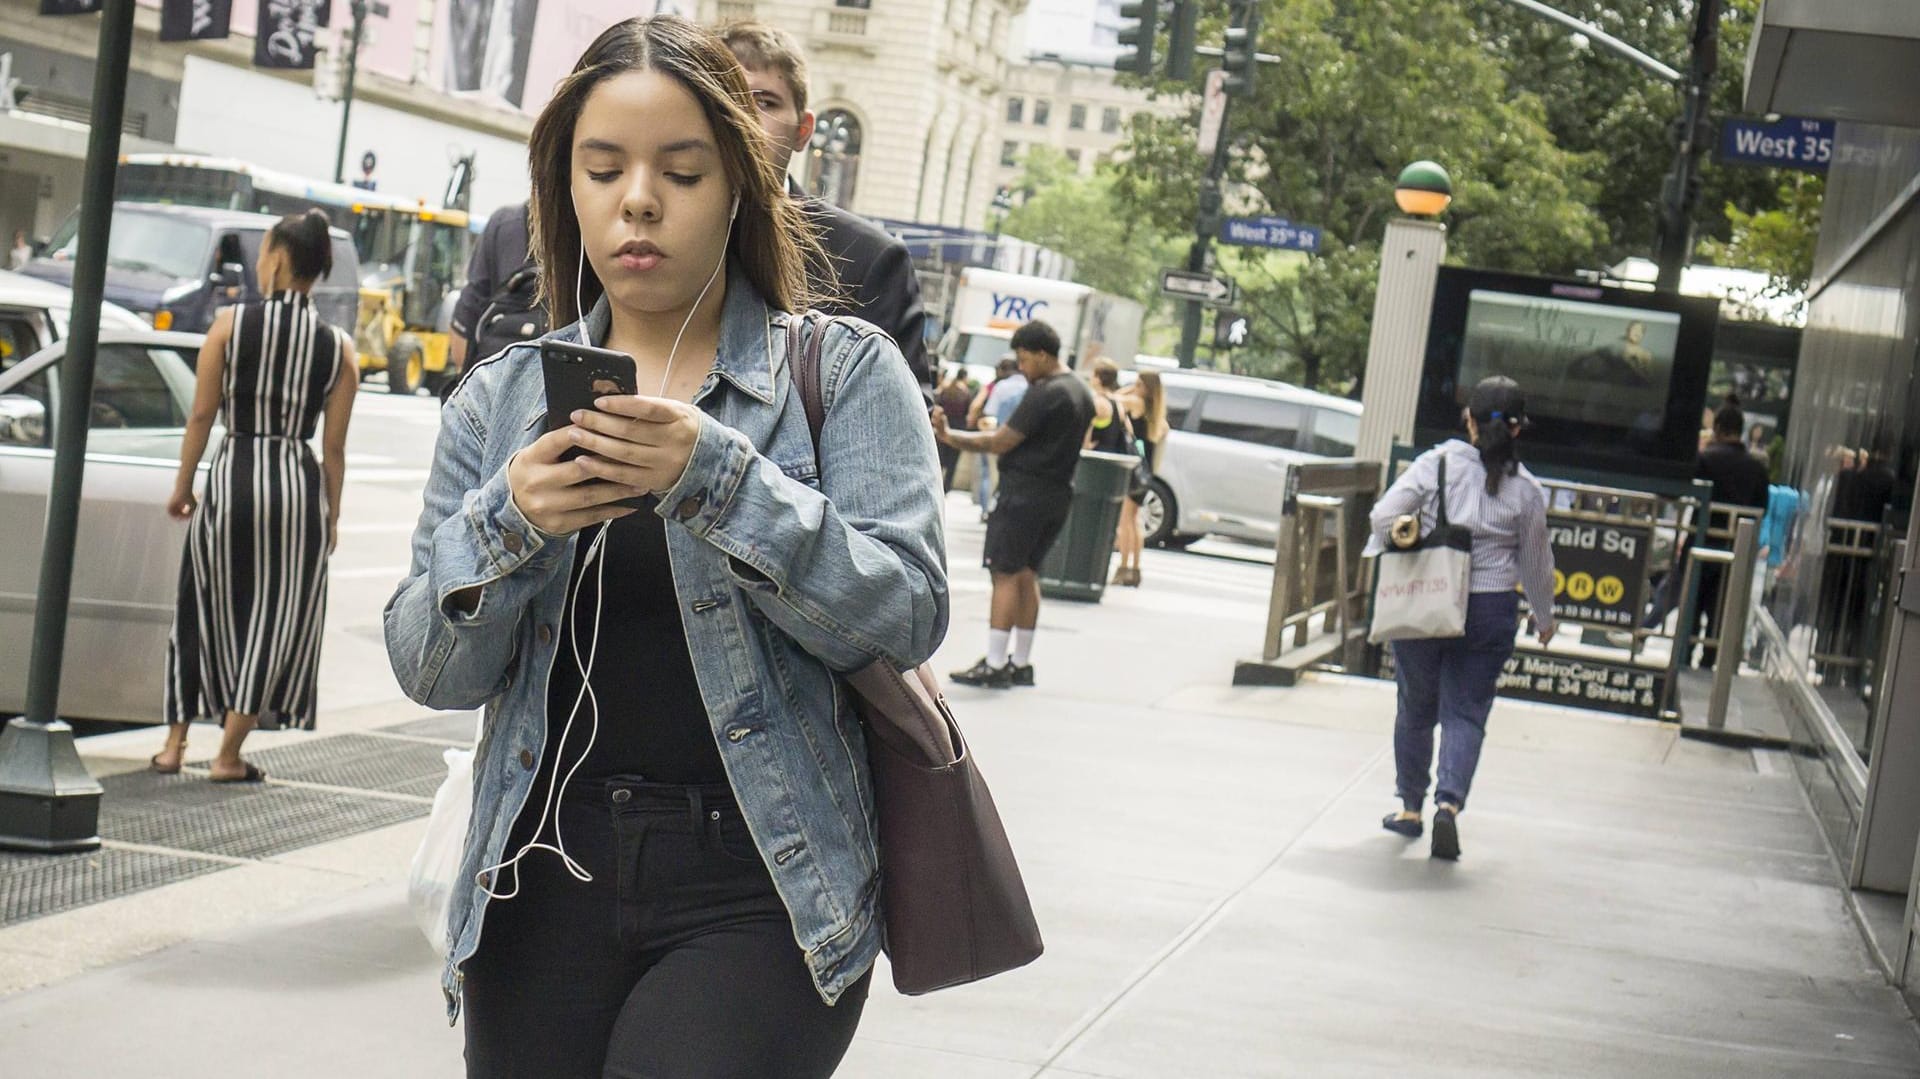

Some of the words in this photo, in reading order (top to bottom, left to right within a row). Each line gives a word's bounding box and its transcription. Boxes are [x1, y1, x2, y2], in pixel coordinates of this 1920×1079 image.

[1735, 128, 1798, 159] West
[1801, 136, 1833, 163] 35
[1230, 221, 1267, 241] West
[1298, 230, 1314, 249] St
[992, 292, 1049, 320] YRC
[1602, 529, 1636, 559] Sq
[1523, 656, 1608, 685] MetroCard
[1612, 672, 1629, 687] at
[1635, 673, 1654, 690] all
[1536, 677, 1553, 691] at
[1557, 679, 1580, 697] 34
[1586, 681, 1636, 704] Street
